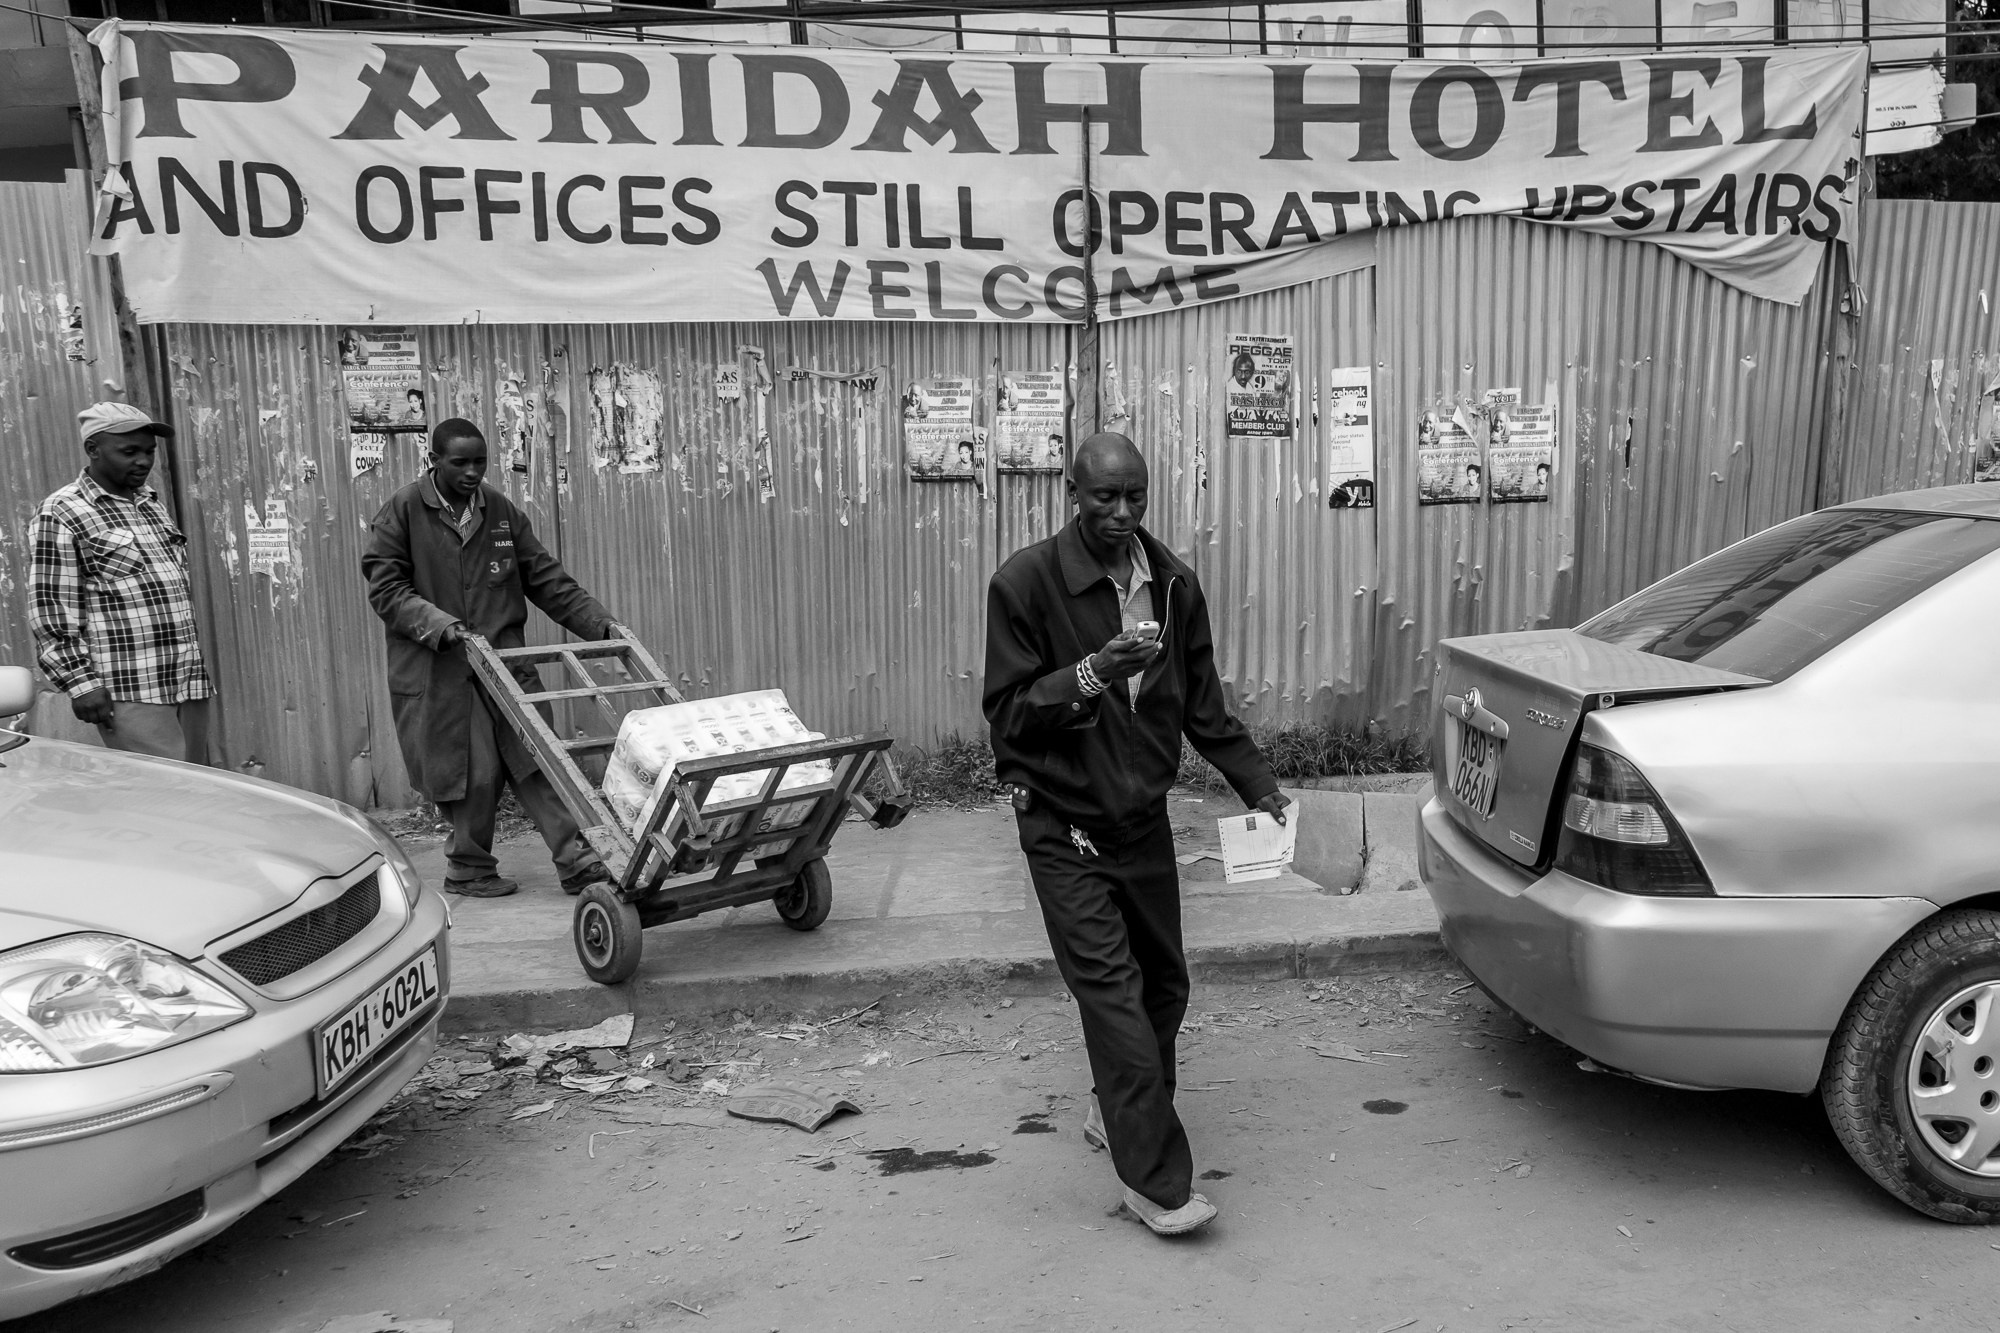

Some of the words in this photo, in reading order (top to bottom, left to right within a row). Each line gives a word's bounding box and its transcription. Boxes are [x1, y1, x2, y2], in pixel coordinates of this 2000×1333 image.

[119, 31, 1150, 158] PARIDAH
[1259, 56, 1818, 162] HOTEL
[102, 157, 304, 239] AND
[355, 165, 721, 245] OFFICES
[771, 180, 1003, 251] STILL
[1520, 173, 1847, 243] UPSTAIRS
[756, 258, 1240, 319] WELCOME
[1230, 345, 1292, 357] REGGAE
[1266, 422, 1285, 430] CLUB
[1346, 486, 1371, 507] yu
[1462, 723, 1486, 762] KBD
[1455, 760, 1491, 814] 066N
[326, 1004, 370, 1081] KBH
[382, 961, 436, 1030] 602L
